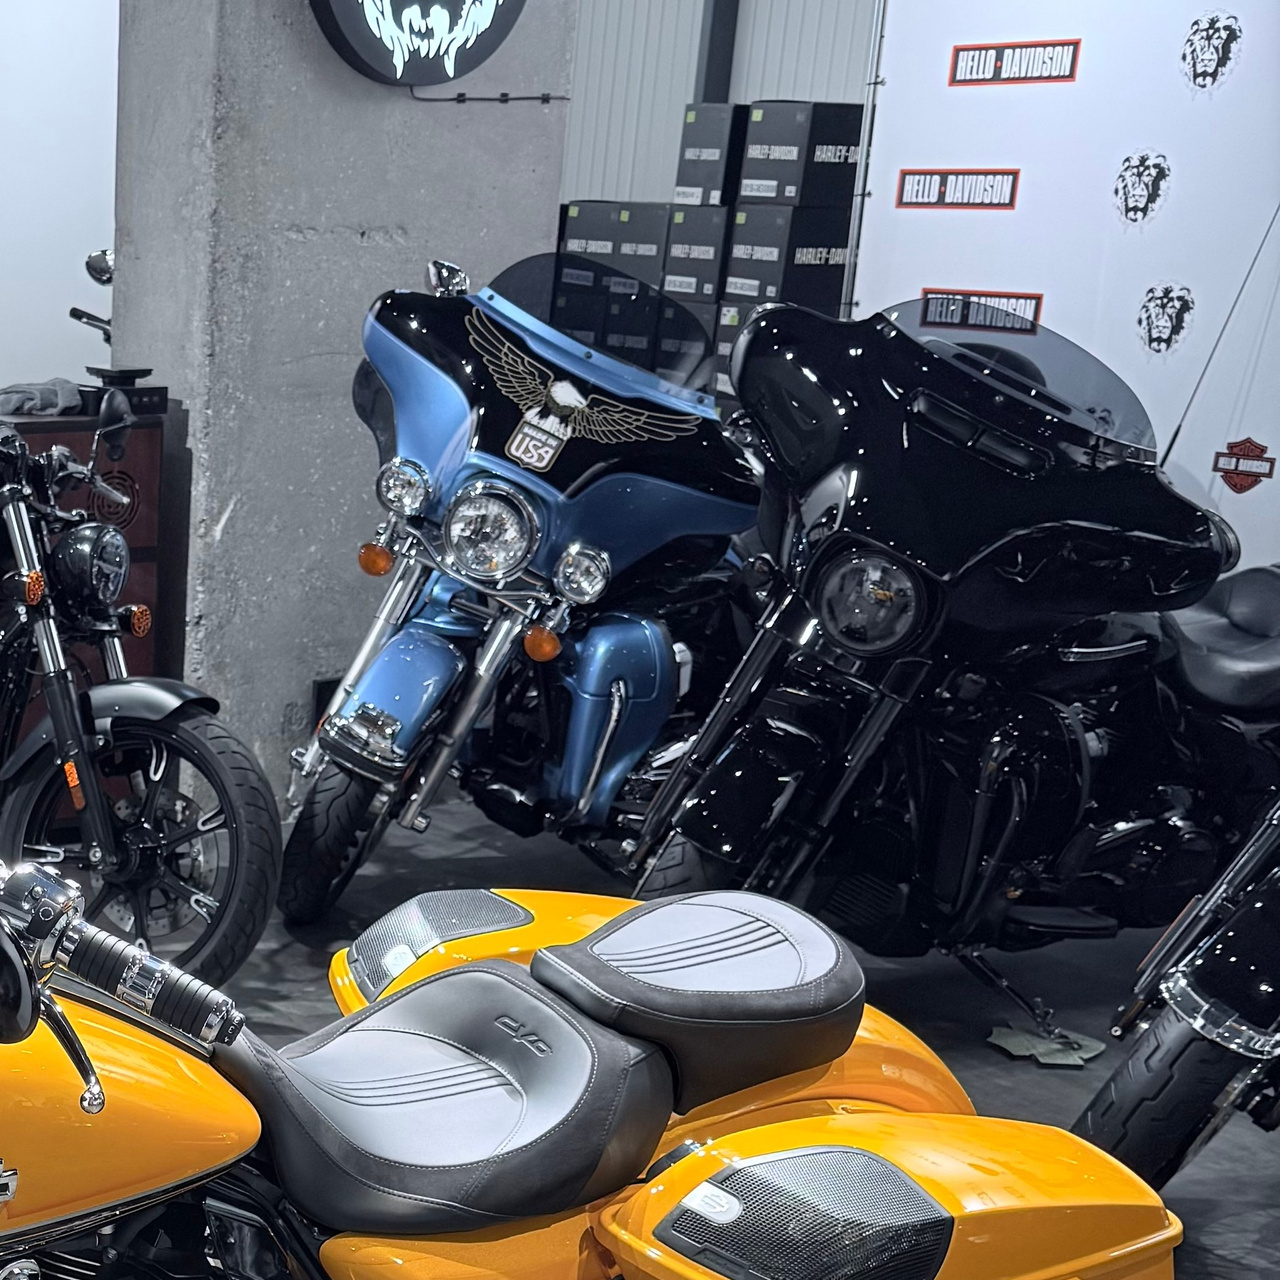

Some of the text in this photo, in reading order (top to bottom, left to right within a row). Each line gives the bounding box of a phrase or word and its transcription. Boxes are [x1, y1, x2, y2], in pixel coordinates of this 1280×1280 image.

[955, 45, 1074, 80] HELLO DAVIDSON
[902, 174, 1014, 204] HELLO DAVIDSON
[926, 293, 1036, 330] HELLO DAVIDSON
[510, 433, 555, 468] USA
